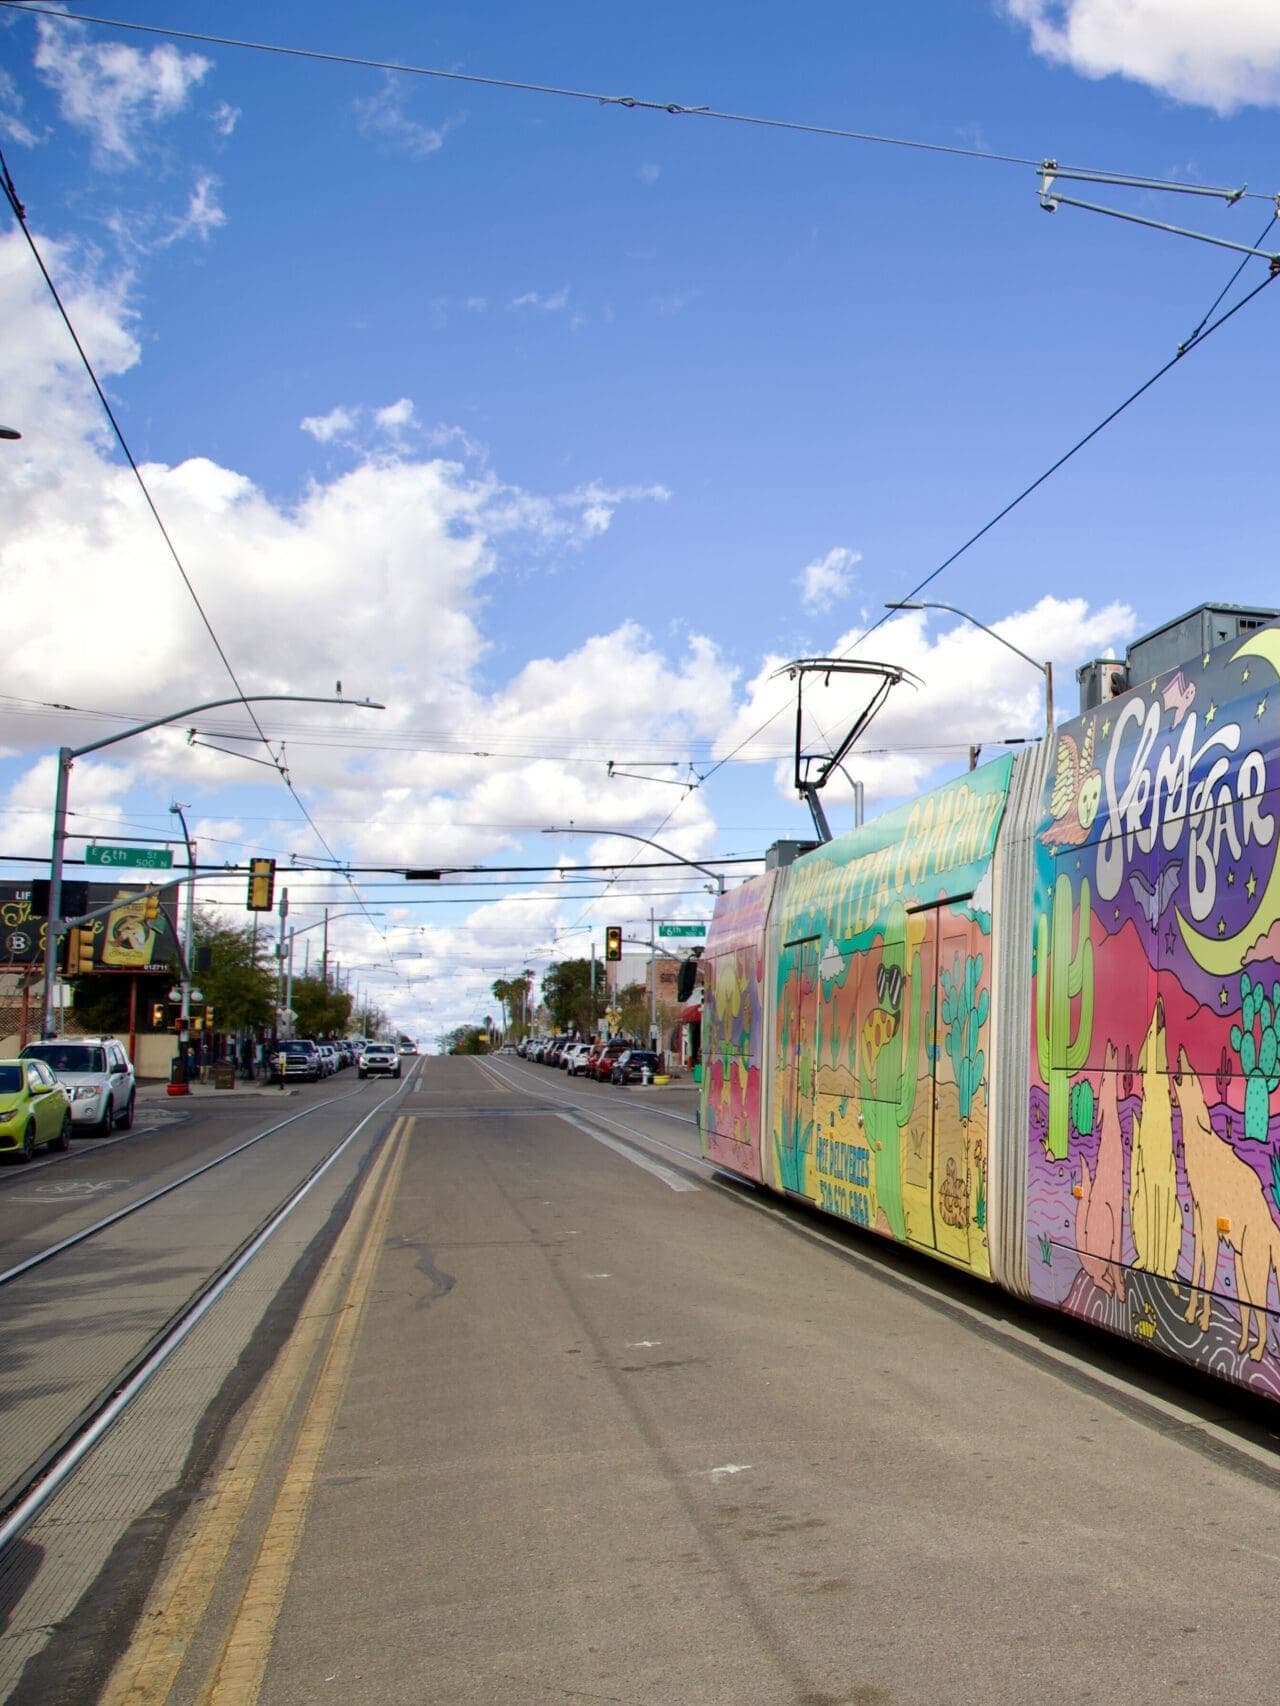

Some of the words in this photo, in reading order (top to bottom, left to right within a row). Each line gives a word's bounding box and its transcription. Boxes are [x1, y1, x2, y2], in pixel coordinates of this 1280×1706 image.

[100, 849, 128, 864] 6th
[146, 851, 158, 859] St
[895, 783, 1005, 894] COMPANY
[1188, 749, 1276, 922] BAR
[666, 927, 682, 936] 6th
